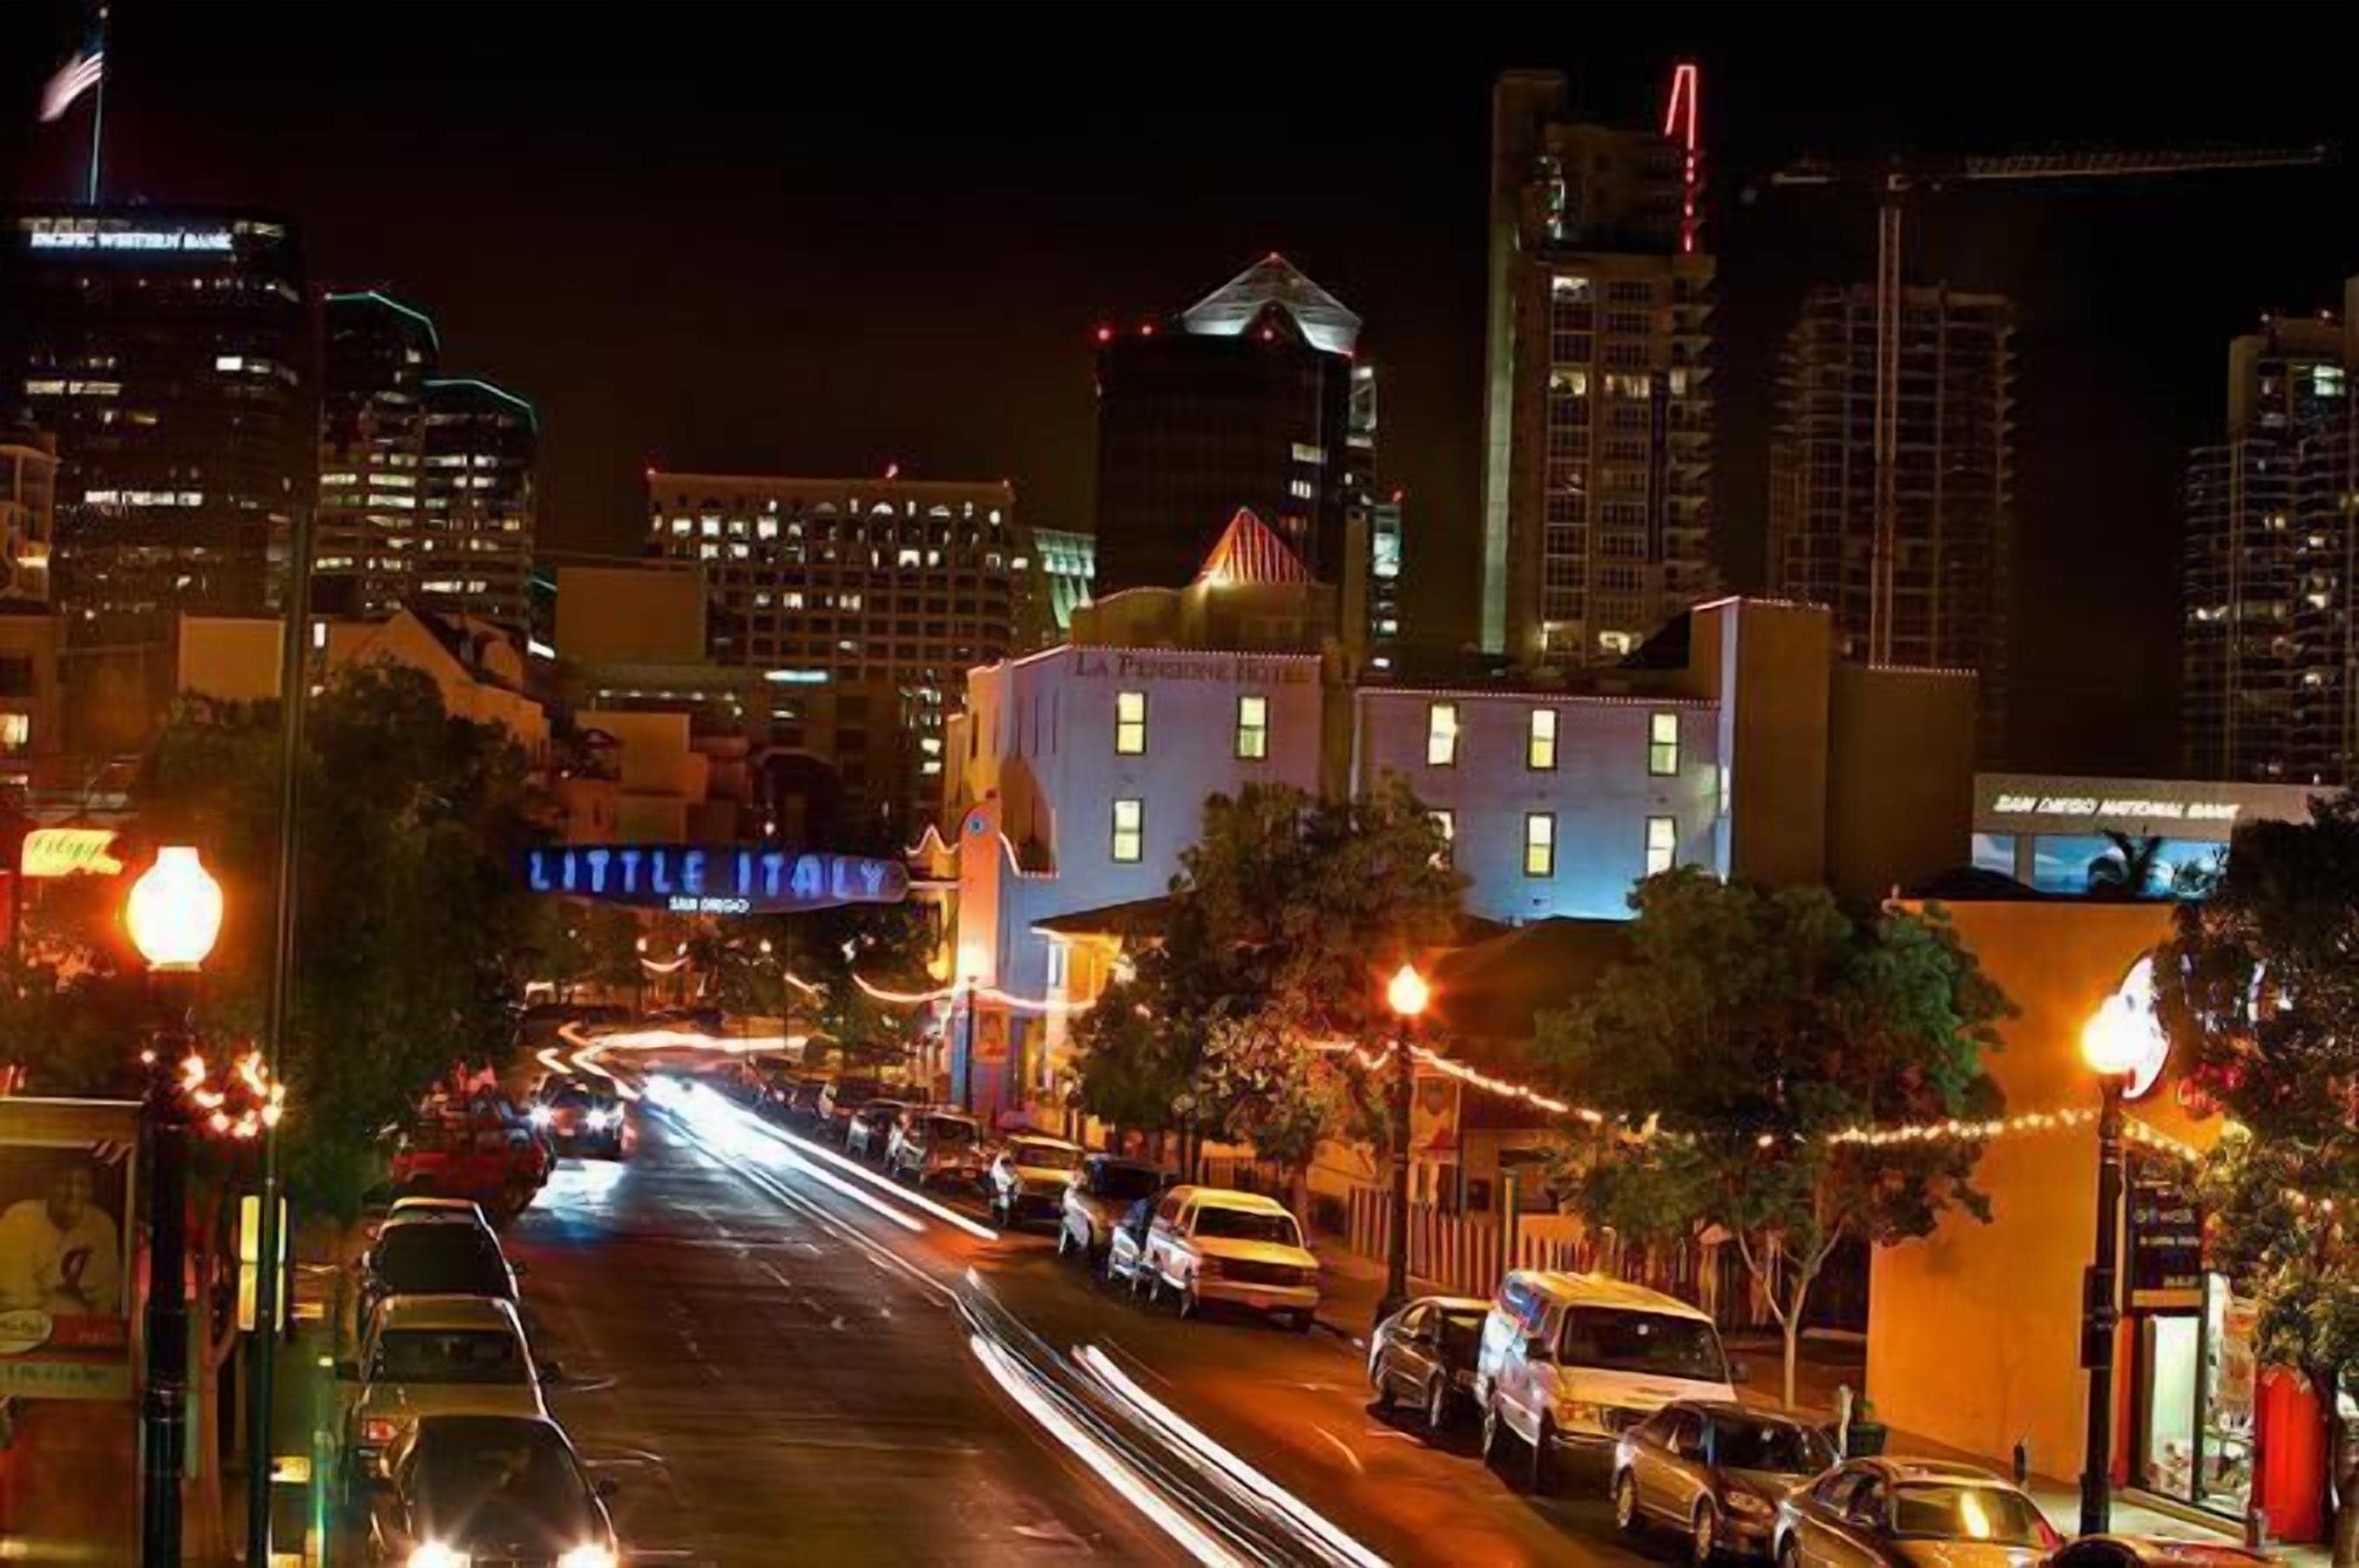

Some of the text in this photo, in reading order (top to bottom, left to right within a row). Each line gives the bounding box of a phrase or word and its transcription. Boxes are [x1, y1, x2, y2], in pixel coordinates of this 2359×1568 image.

[1993, 794, 2241, 820] SAN DIEGO NATIONAL BANK
[530, 849, 887, 898] LITTLE ITALY
[669, 896, 698, 910] SAN
